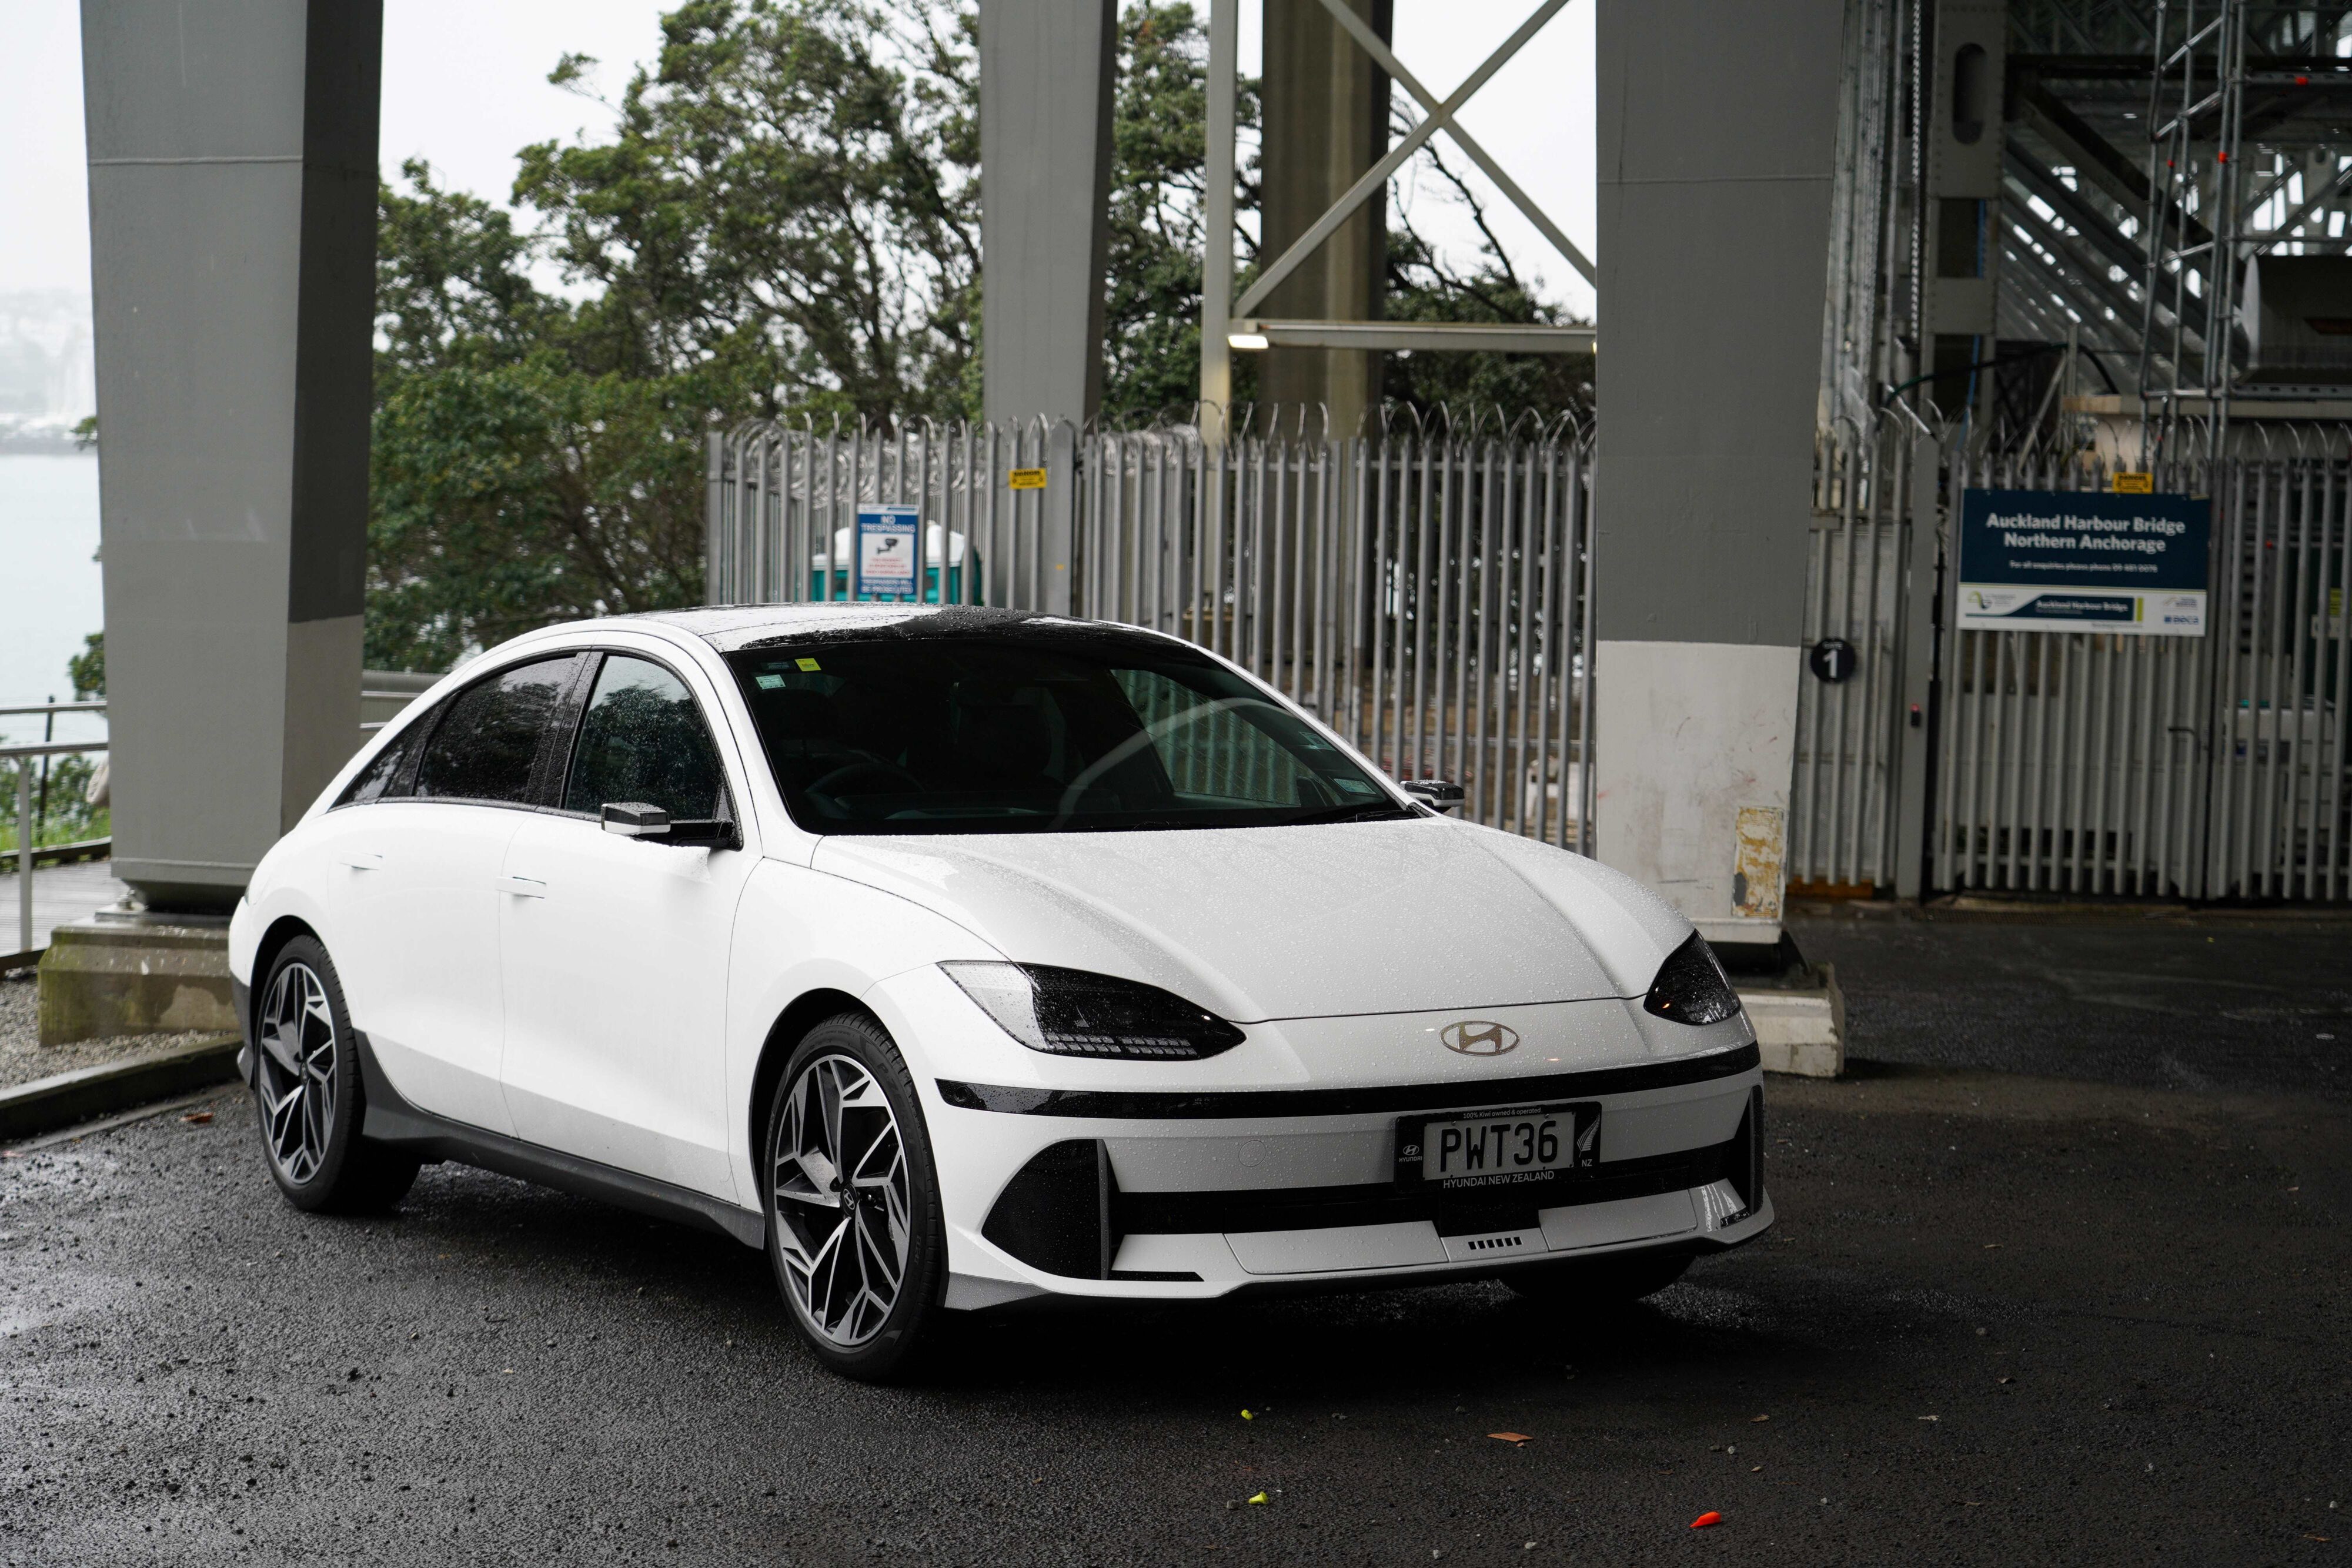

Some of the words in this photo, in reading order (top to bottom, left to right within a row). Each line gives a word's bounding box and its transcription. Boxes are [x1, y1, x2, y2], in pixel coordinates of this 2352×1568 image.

[860, 523, 916, 533] TRESPASSING
[881, 515, 896, 524] NO
[1986, 513, 2061, 530] Auckland
[2064, 515, 2131, 532] Harbour
[2133, 516, 2186, 536] Bridge
[2004, 532, 2076, 549] Northern
[2079, 534, 2167, 554] Anchorage
[2036, 599, 2071, 610] Auckland
[2072, 600, 2102, 610] Harbour
[2103, 601, 2129, 613] Bridge
[1823, 649, 1838, 678] 1
[1441, 1120, 1558, 1172] PWT36
[1582, 1159, 1592, 1167] NZ
[1443, 1176, 1486, 1189] HYUNDAI
[1488, 1174, 1511, 1185] NEW
[1512, 1171, 1555, 1183] ZEALAND
